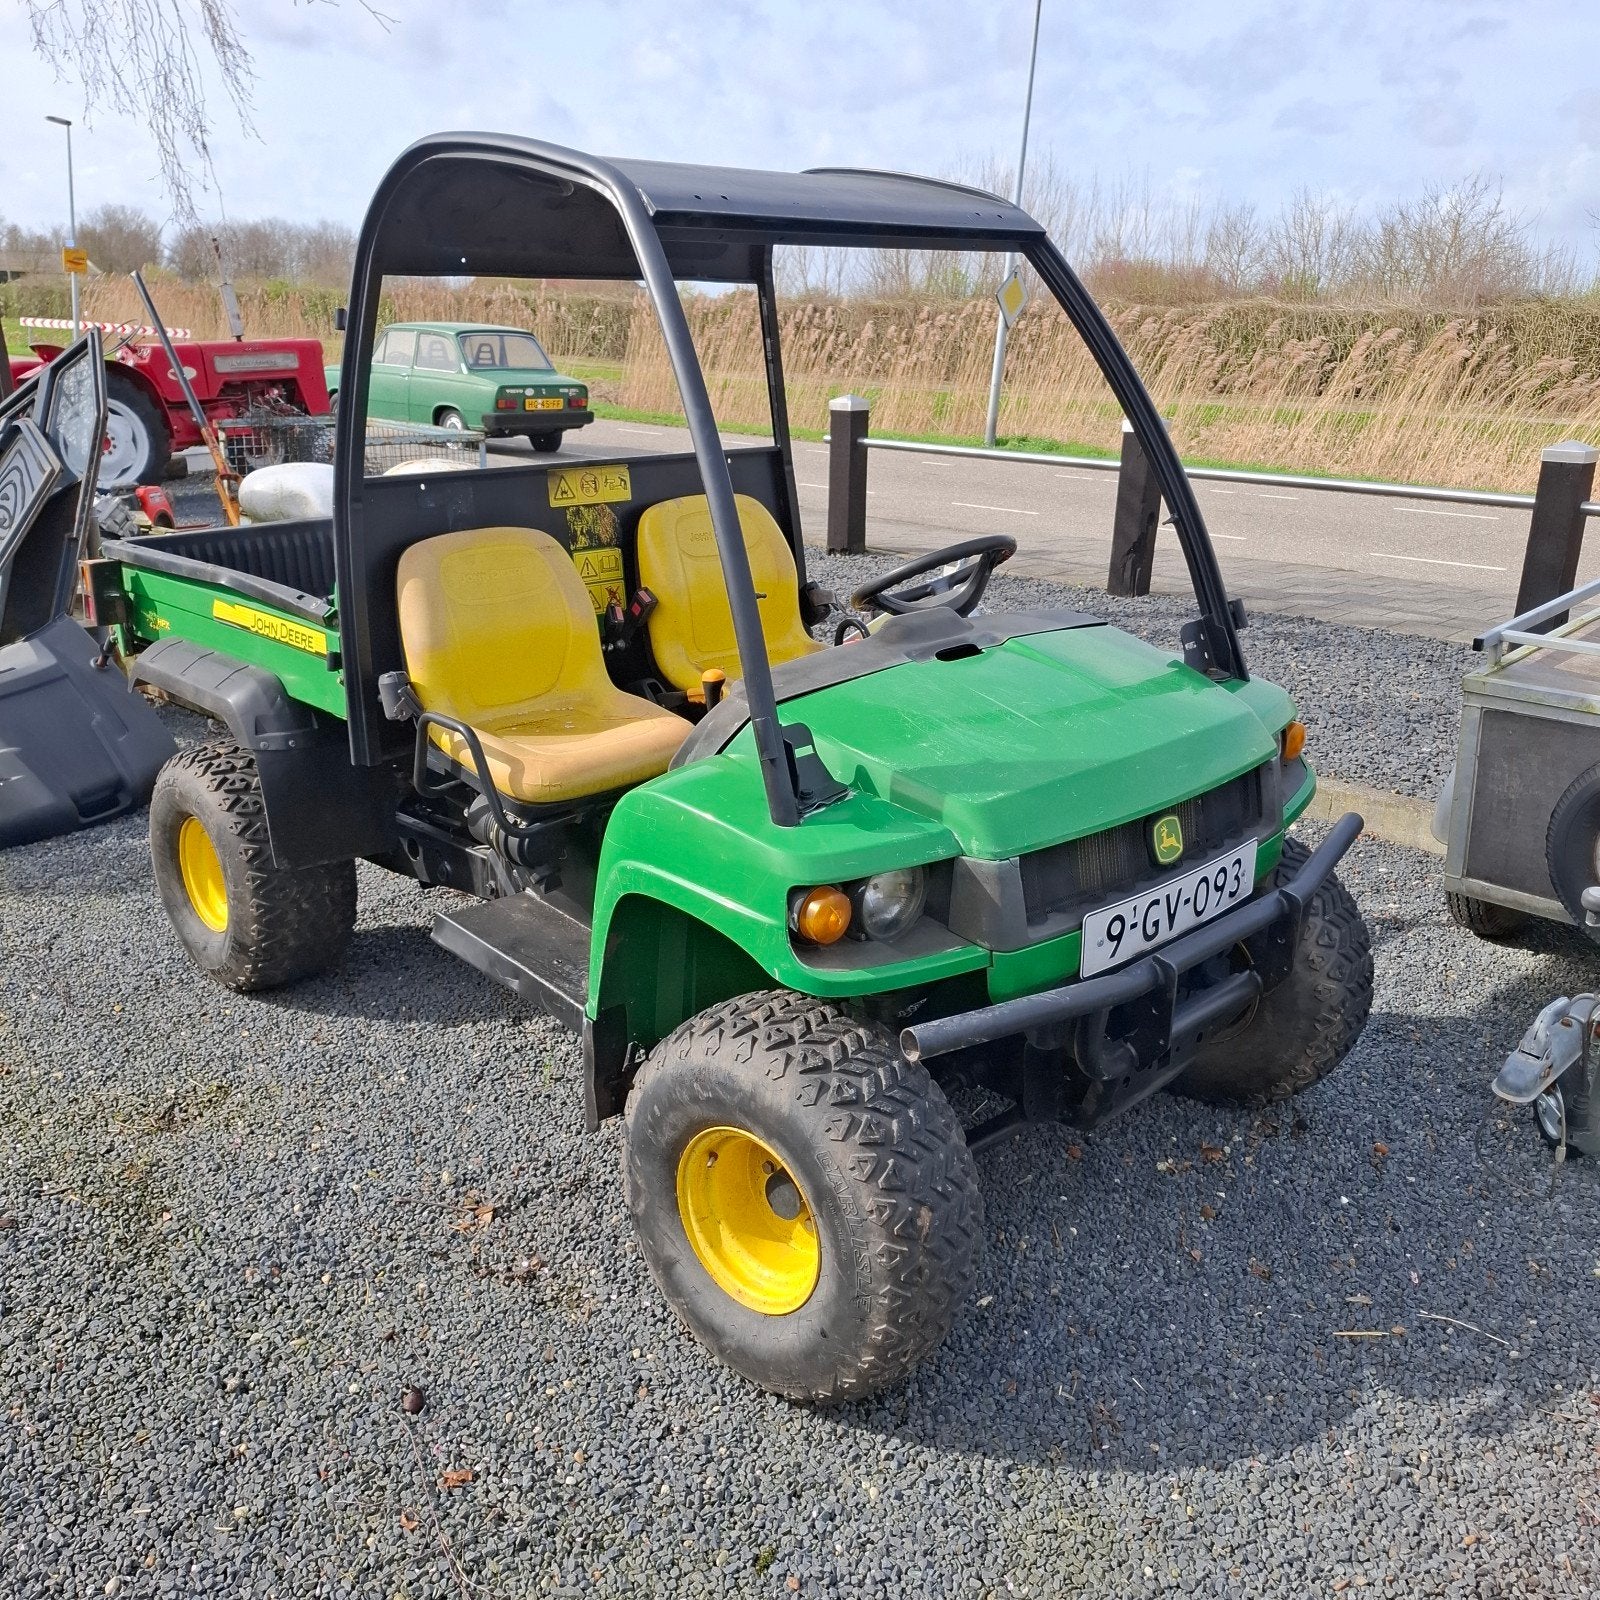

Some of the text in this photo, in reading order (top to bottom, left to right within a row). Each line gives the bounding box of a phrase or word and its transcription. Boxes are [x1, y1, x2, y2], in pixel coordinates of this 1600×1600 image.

[251, 613, 314, 649] JOHN DEERE
[1106, 858, 1242, 959] 9-GV-093
[815, 1150, 873, 1314] CARLISLE
